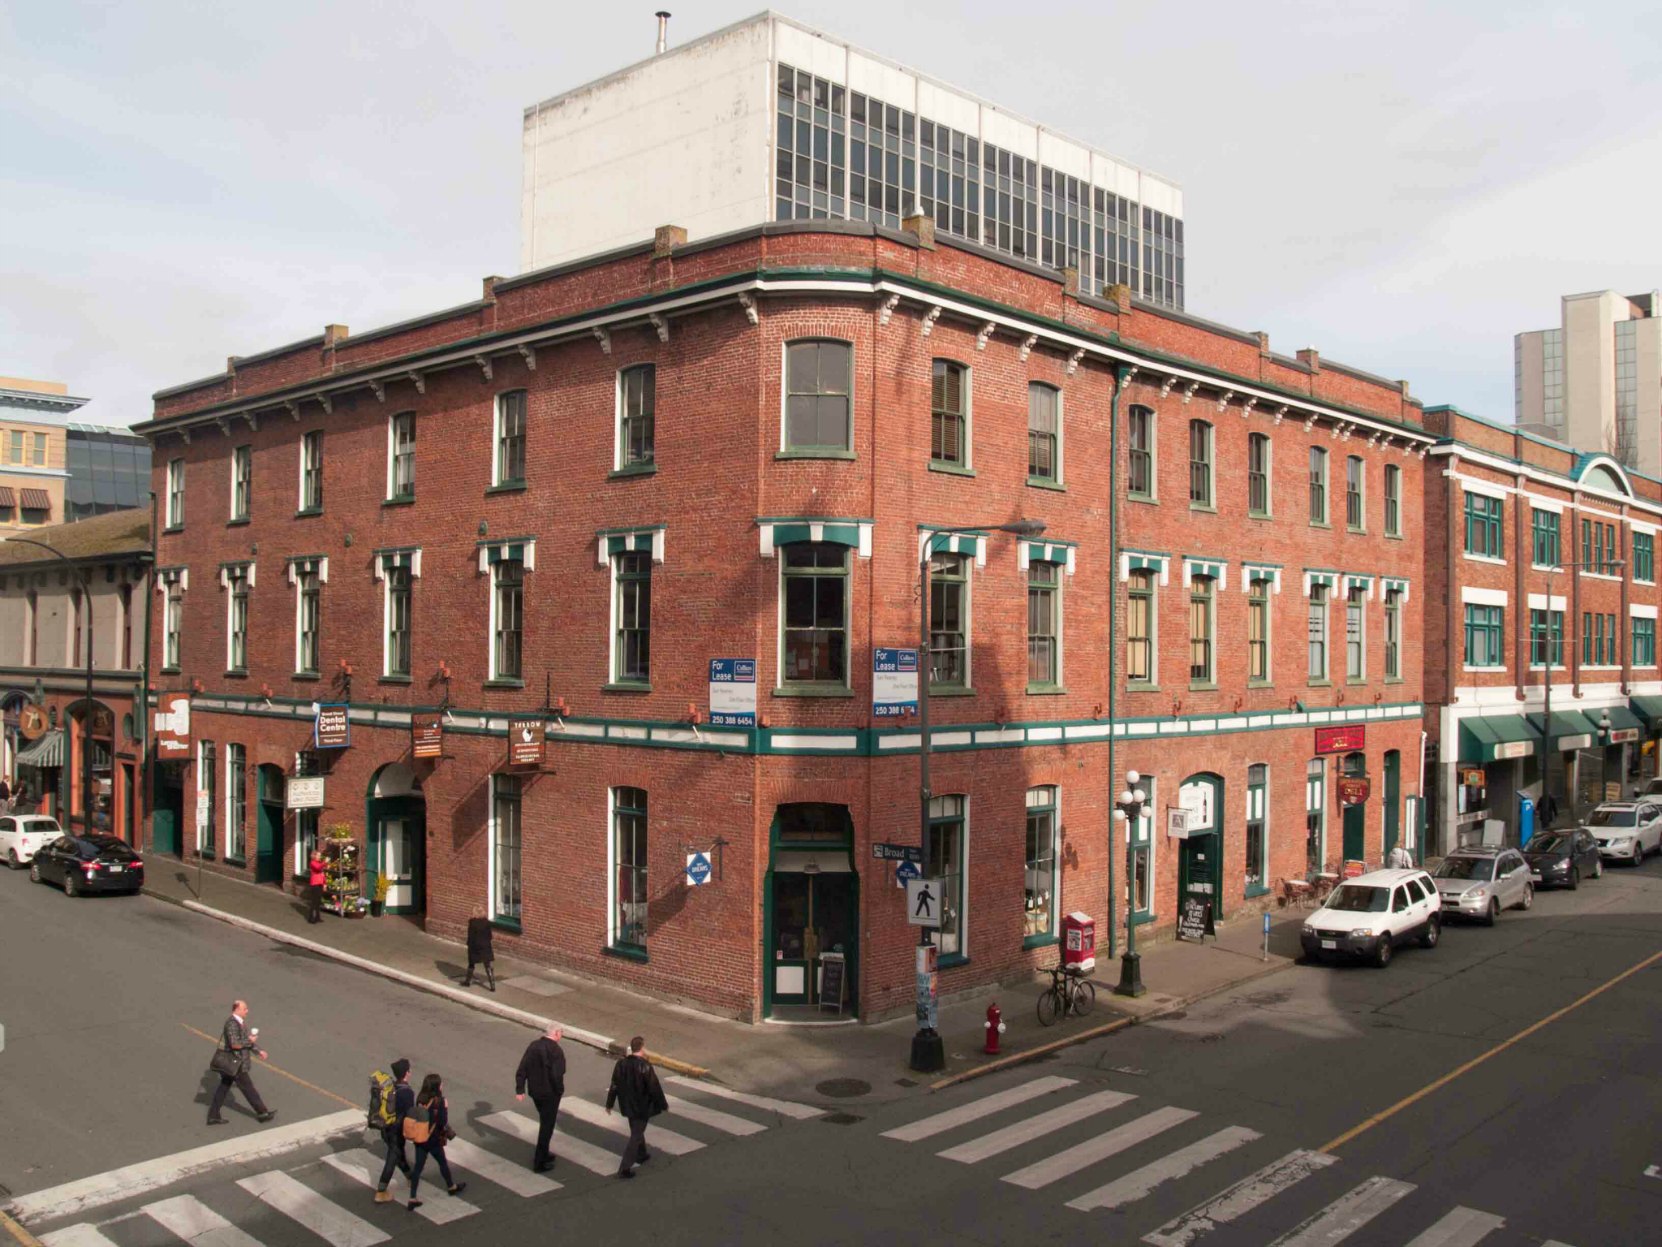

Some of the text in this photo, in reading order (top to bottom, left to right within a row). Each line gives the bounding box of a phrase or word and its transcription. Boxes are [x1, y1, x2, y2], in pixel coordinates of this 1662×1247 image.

[876, 650, 887, 660] For
[712, 660, 723, 670] For
[875, 661, 896, 671] Lease
[712, 671, 732, 680] Lease
[875, 706, 888, 715] 250
[320, 715, 346, 724] Dental
[712, 716, 753, 725] 250 388 6454
[320, 724, 346, 732] Centre
[884, 847, 905, 858] Broad
